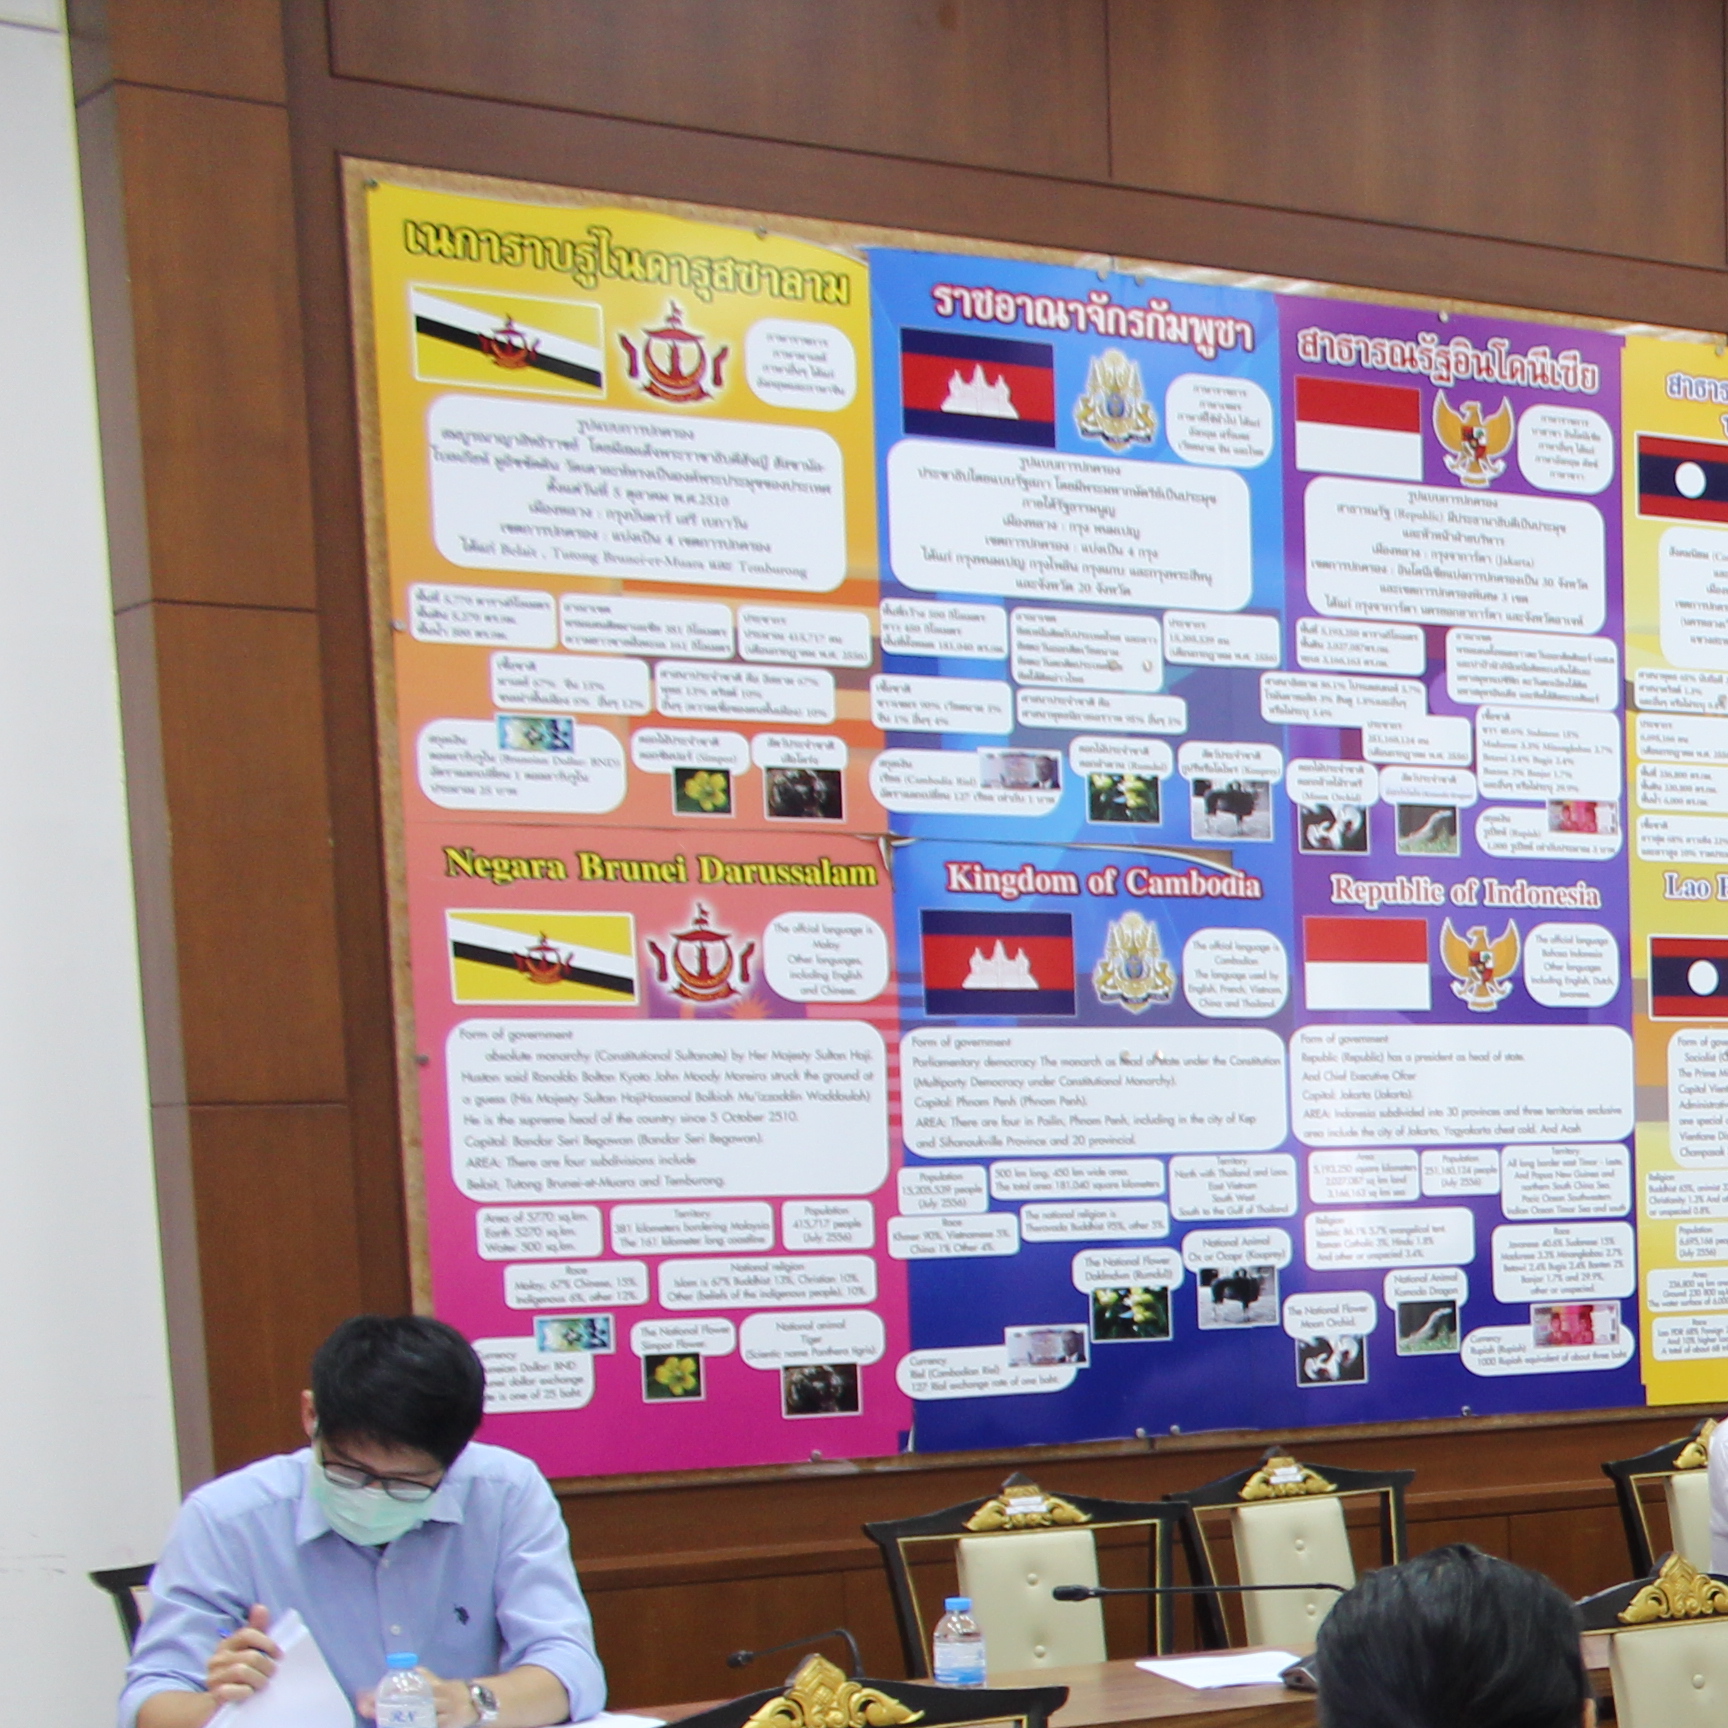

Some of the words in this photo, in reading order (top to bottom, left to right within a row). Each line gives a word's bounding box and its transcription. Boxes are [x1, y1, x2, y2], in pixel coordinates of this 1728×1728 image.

[932, 284, 1254, 361] ราชอาณาจักรกัมพูชา
[1297, 327, 1599, 394] สาธารณรัฐอินโดนีเซีย
[443, 846, 567, 886] Negara
[578, 850, 687, 884] Brunei
[697, 854, 878, 887] Darussalam
[945, 862, 1081, 900] Kingdom
[1087, 867, 1117, 896] of
[1126, 866, 1263, 899] Cambodia
[1331, 874, 1445, 910] Republic
[1450, 878, 1479, 906] of
[1483, 879, 1601, 909] Indonesia
[1664, 873, 1711, 900] Lao
